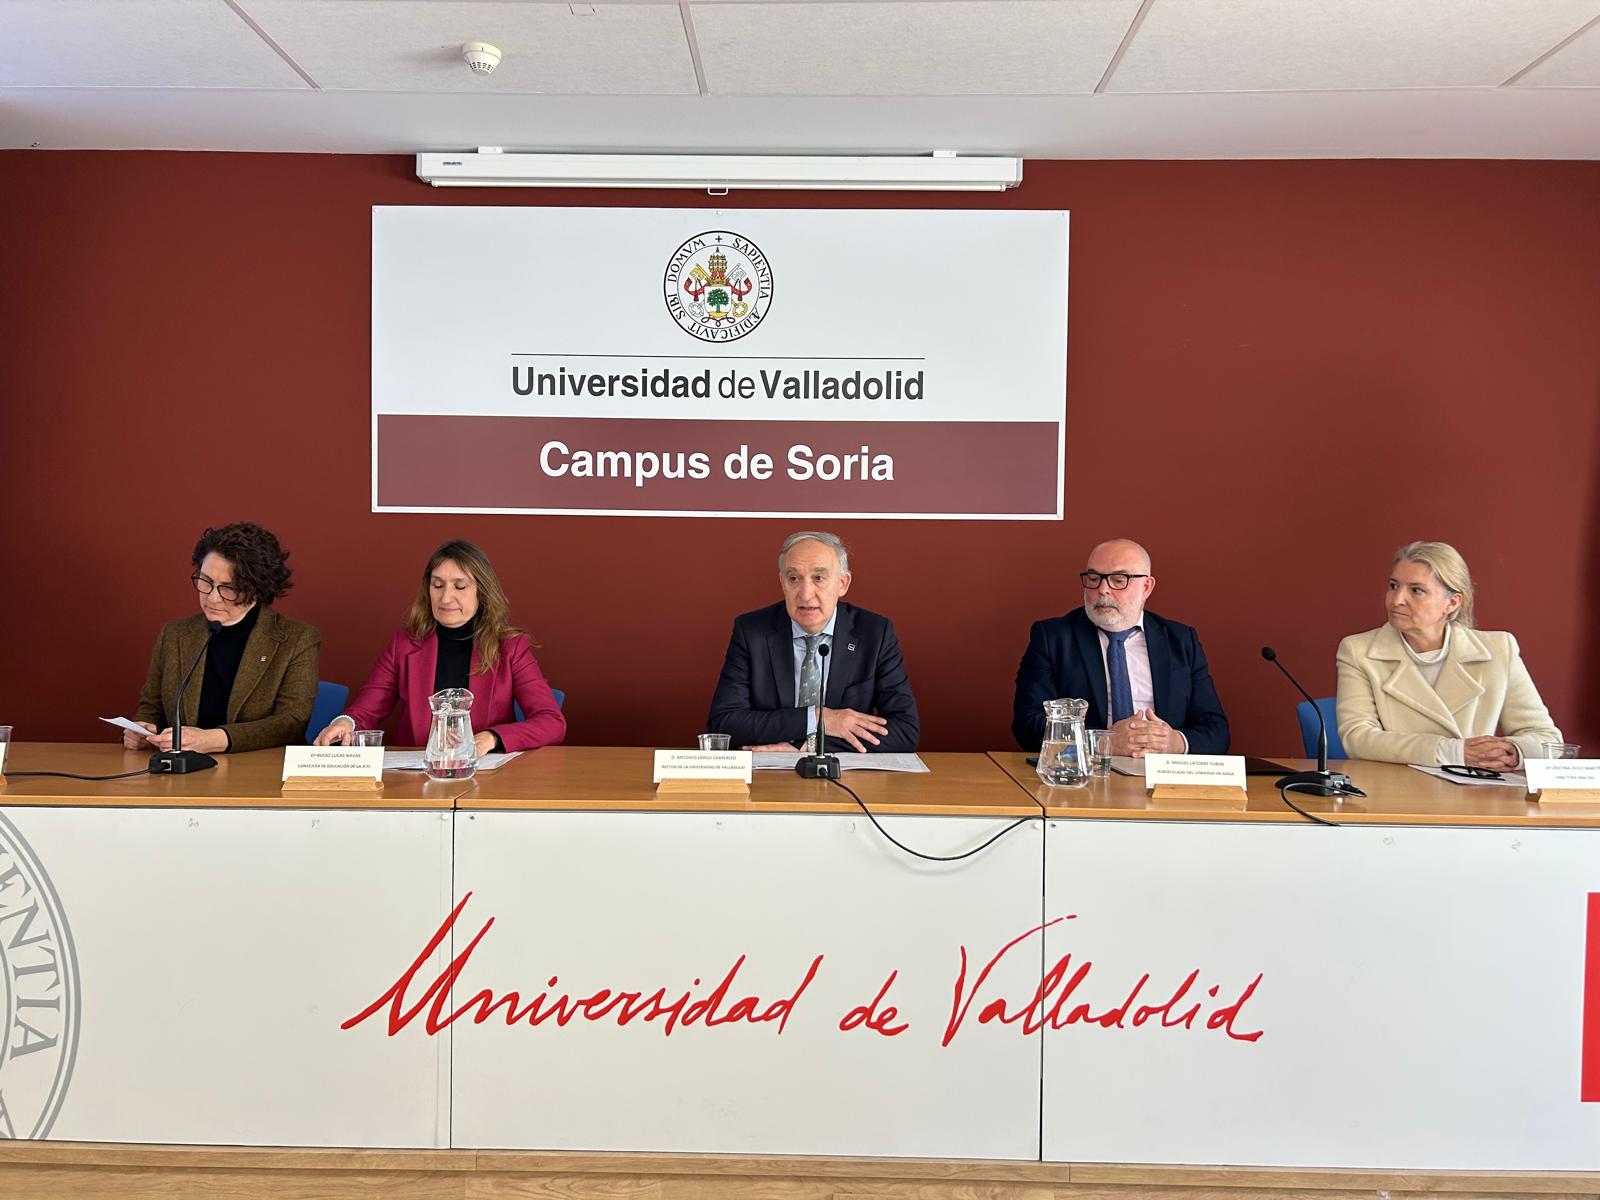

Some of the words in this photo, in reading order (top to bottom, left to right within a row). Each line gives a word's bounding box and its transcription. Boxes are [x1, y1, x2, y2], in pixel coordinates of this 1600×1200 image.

[667, 238, 706, 283] DOMVM
[732, 237, 770, 299] SAPIENTIA
[667, 293, 686, 320] SIBI
[687, 307, 761, 340] ÆDIFICAVIT
[512, 366, 711, 399] Universidad
[718, 369, 756, 399] de
[759, 369, 924, 401] Valladolid
[539, 440, 711, 487] Campus
[724, 444, 774, 480] de
[786, 444, 895, 481] Soria
[341, 892, 823, 1037] Universidad
[839, 970, 909, 1036] de
[941, 914, 1264, 1047] Valladolid
